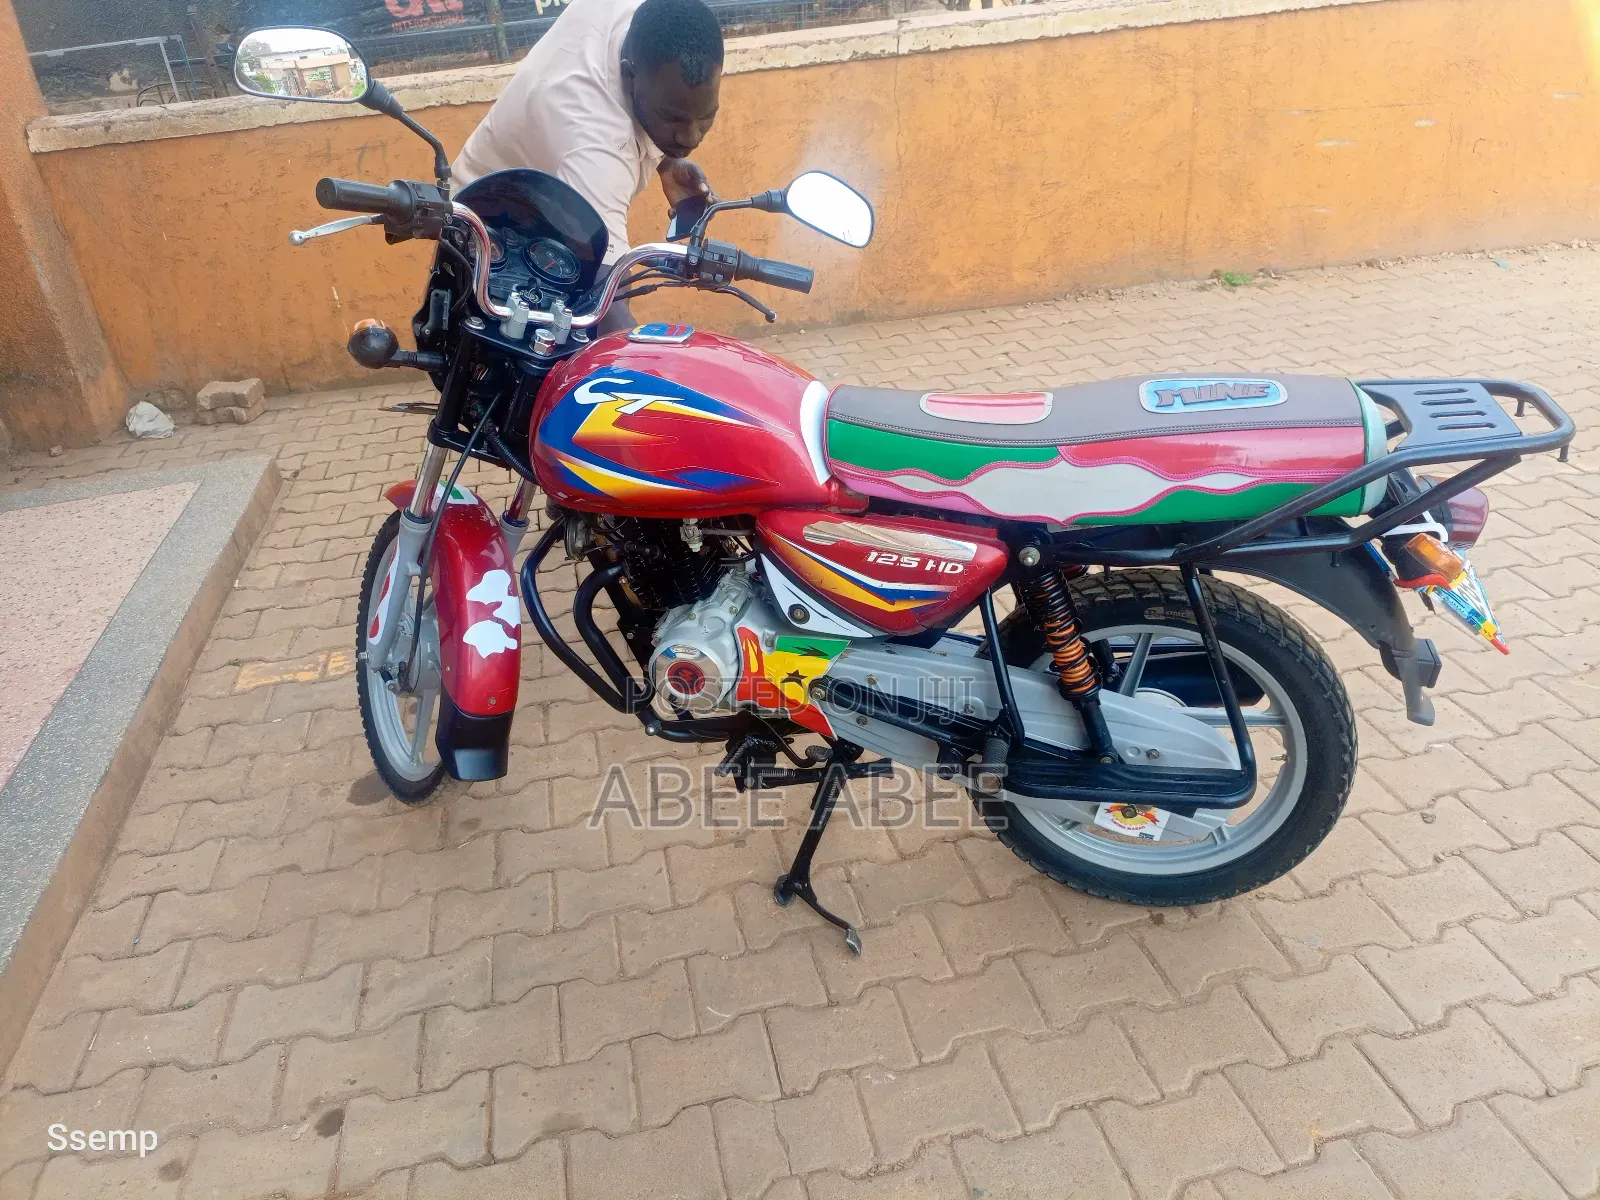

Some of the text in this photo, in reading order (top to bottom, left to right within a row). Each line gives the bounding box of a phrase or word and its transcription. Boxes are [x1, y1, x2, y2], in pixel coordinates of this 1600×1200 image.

[1155, 382, 1271, 408] MINE
[866, 550, 965, 575] 125 HD
